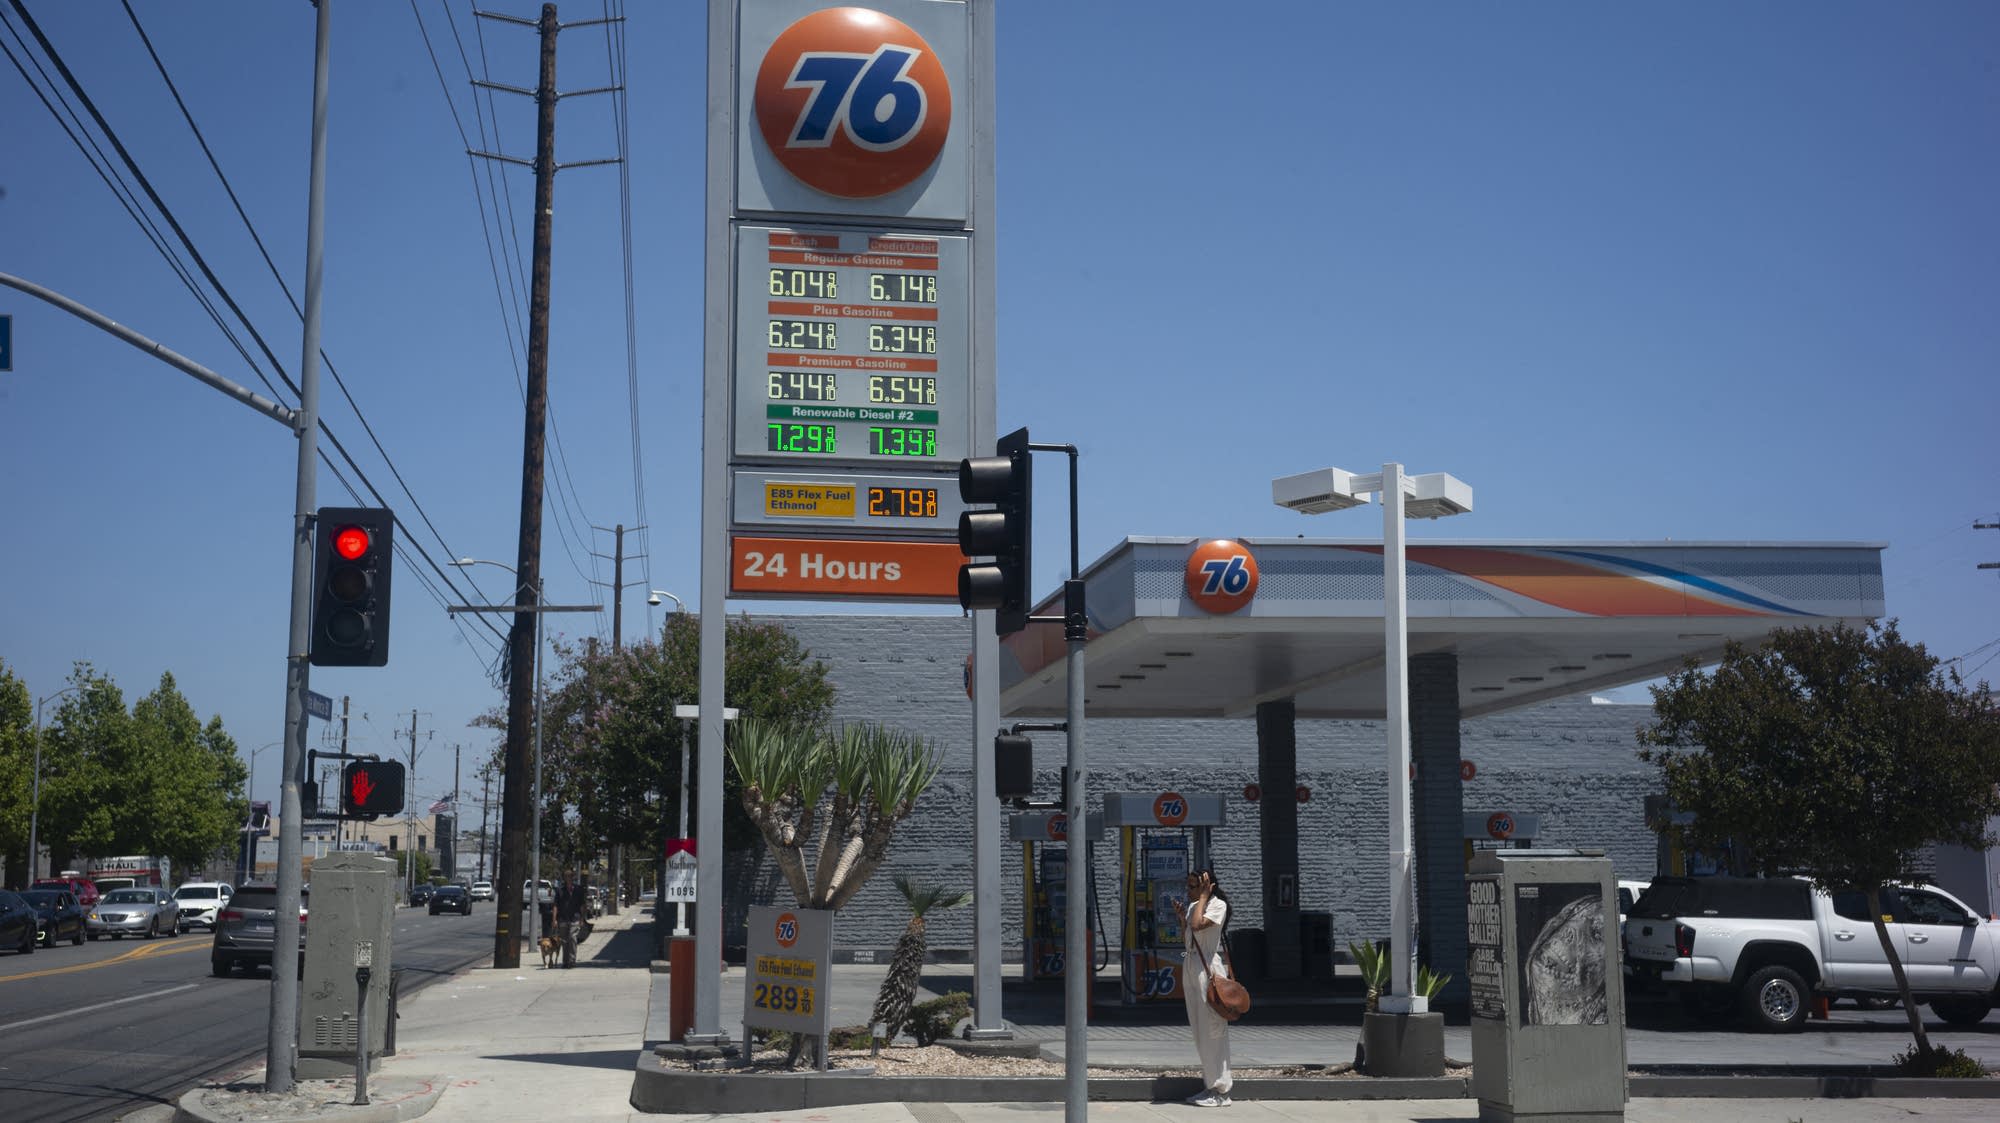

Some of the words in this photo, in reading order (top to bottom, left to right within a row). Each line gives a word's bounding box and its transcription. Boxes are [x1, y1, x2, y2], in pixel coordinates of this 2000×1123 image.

[784, 43, 928, 152] 76
[791, 236, 817, 247] Cash
[871, 240, 935, 252] Credit/Debit
[804, 253, 849, 265] Regular
[853, 255, 904, 266] Gasoline
[813, 305, 839, 315] Plus
[842, 306, 893, 318] Gasoline
[799, 356, 852, 367] Premium
[856, 358, 906, 370] Gasoline
[792, 407, 856, 418] Renewable
[860, 409, 895, 420] Diesel
[898, 411, 914, 421] #2
[771, 488, 794, 499] E85
[797, 489, 822, 500] Flex
[826, 490, 850, 501] Fuel
[771, 500, 817, 511] Ethanol
[744, 552, 787, 577] 24
[800, 553, 901, 581] Hours
[1201, 555, 1251, 595] 76
[1160, 801, 1184, 817] 76
[1492, 819, 1510, 832] 76
[95, 862, 136, 871] U-HAUL
[1470, 882, 1495, 904] GOOD
[1467, 903, 1500, 924] MOTHER
[777, 920, 797, 941] 76
[1468, 923, 1500, 945] GALLERY
[1141, 966, 1175, 996] 76
